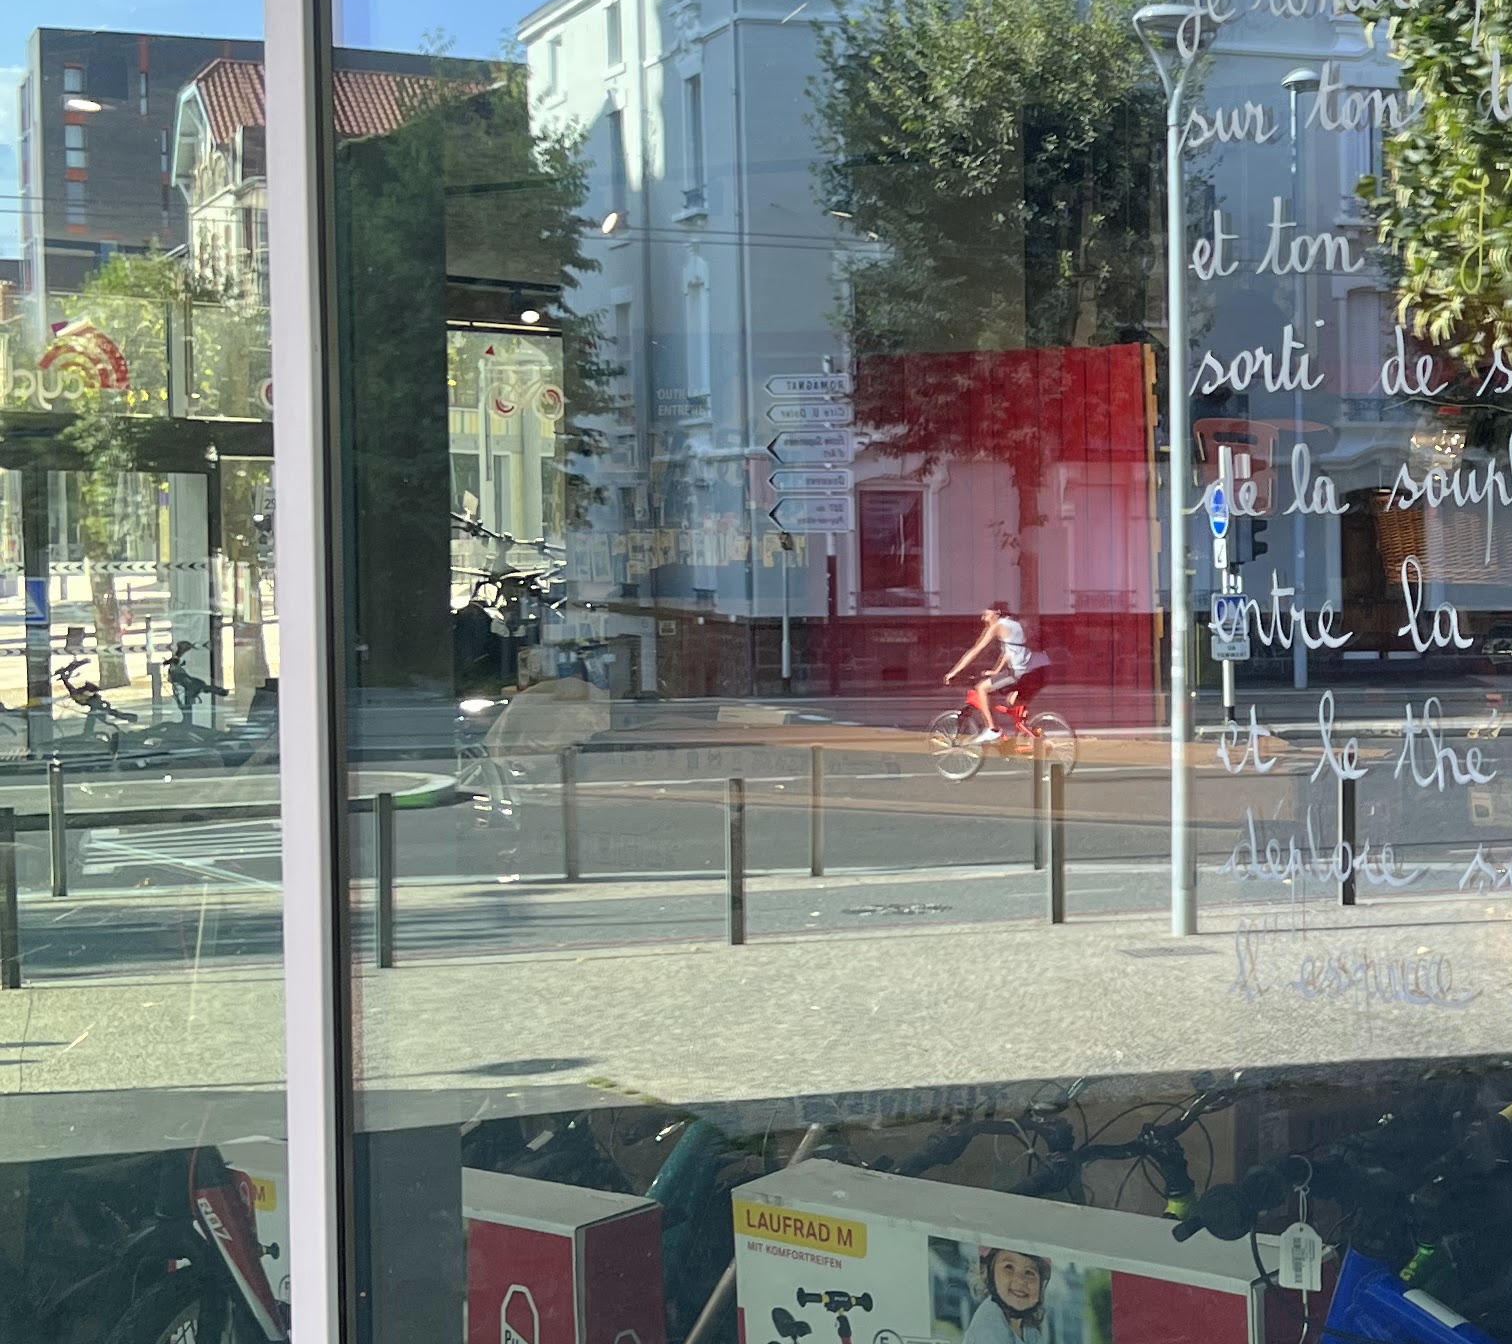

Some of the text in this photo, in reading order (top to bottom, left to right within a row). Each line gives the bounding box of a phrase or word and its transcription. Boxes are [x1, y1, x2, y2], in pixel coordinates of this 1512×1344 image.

[1176, 100, 1279, 156] sur
[1304, 60, 1426, 132] ton
[1189, 209, 1239, 282] et
[1255, 195, 1365, 275] ton
[1189, 319, 1326, 397] sorti
[1378, 324, 1449, 397] de
[1282, 442, 1351, 517] la
[1209, 568, 1353, 651] entre
[1398, 554, 1474, 654] la
[1310, 690, 1369, 784] le
[745, 1208, 854, 1248] LAUFRAD M
[746, 1240, 843, 1270] MIT KOMFORTREIFEN
